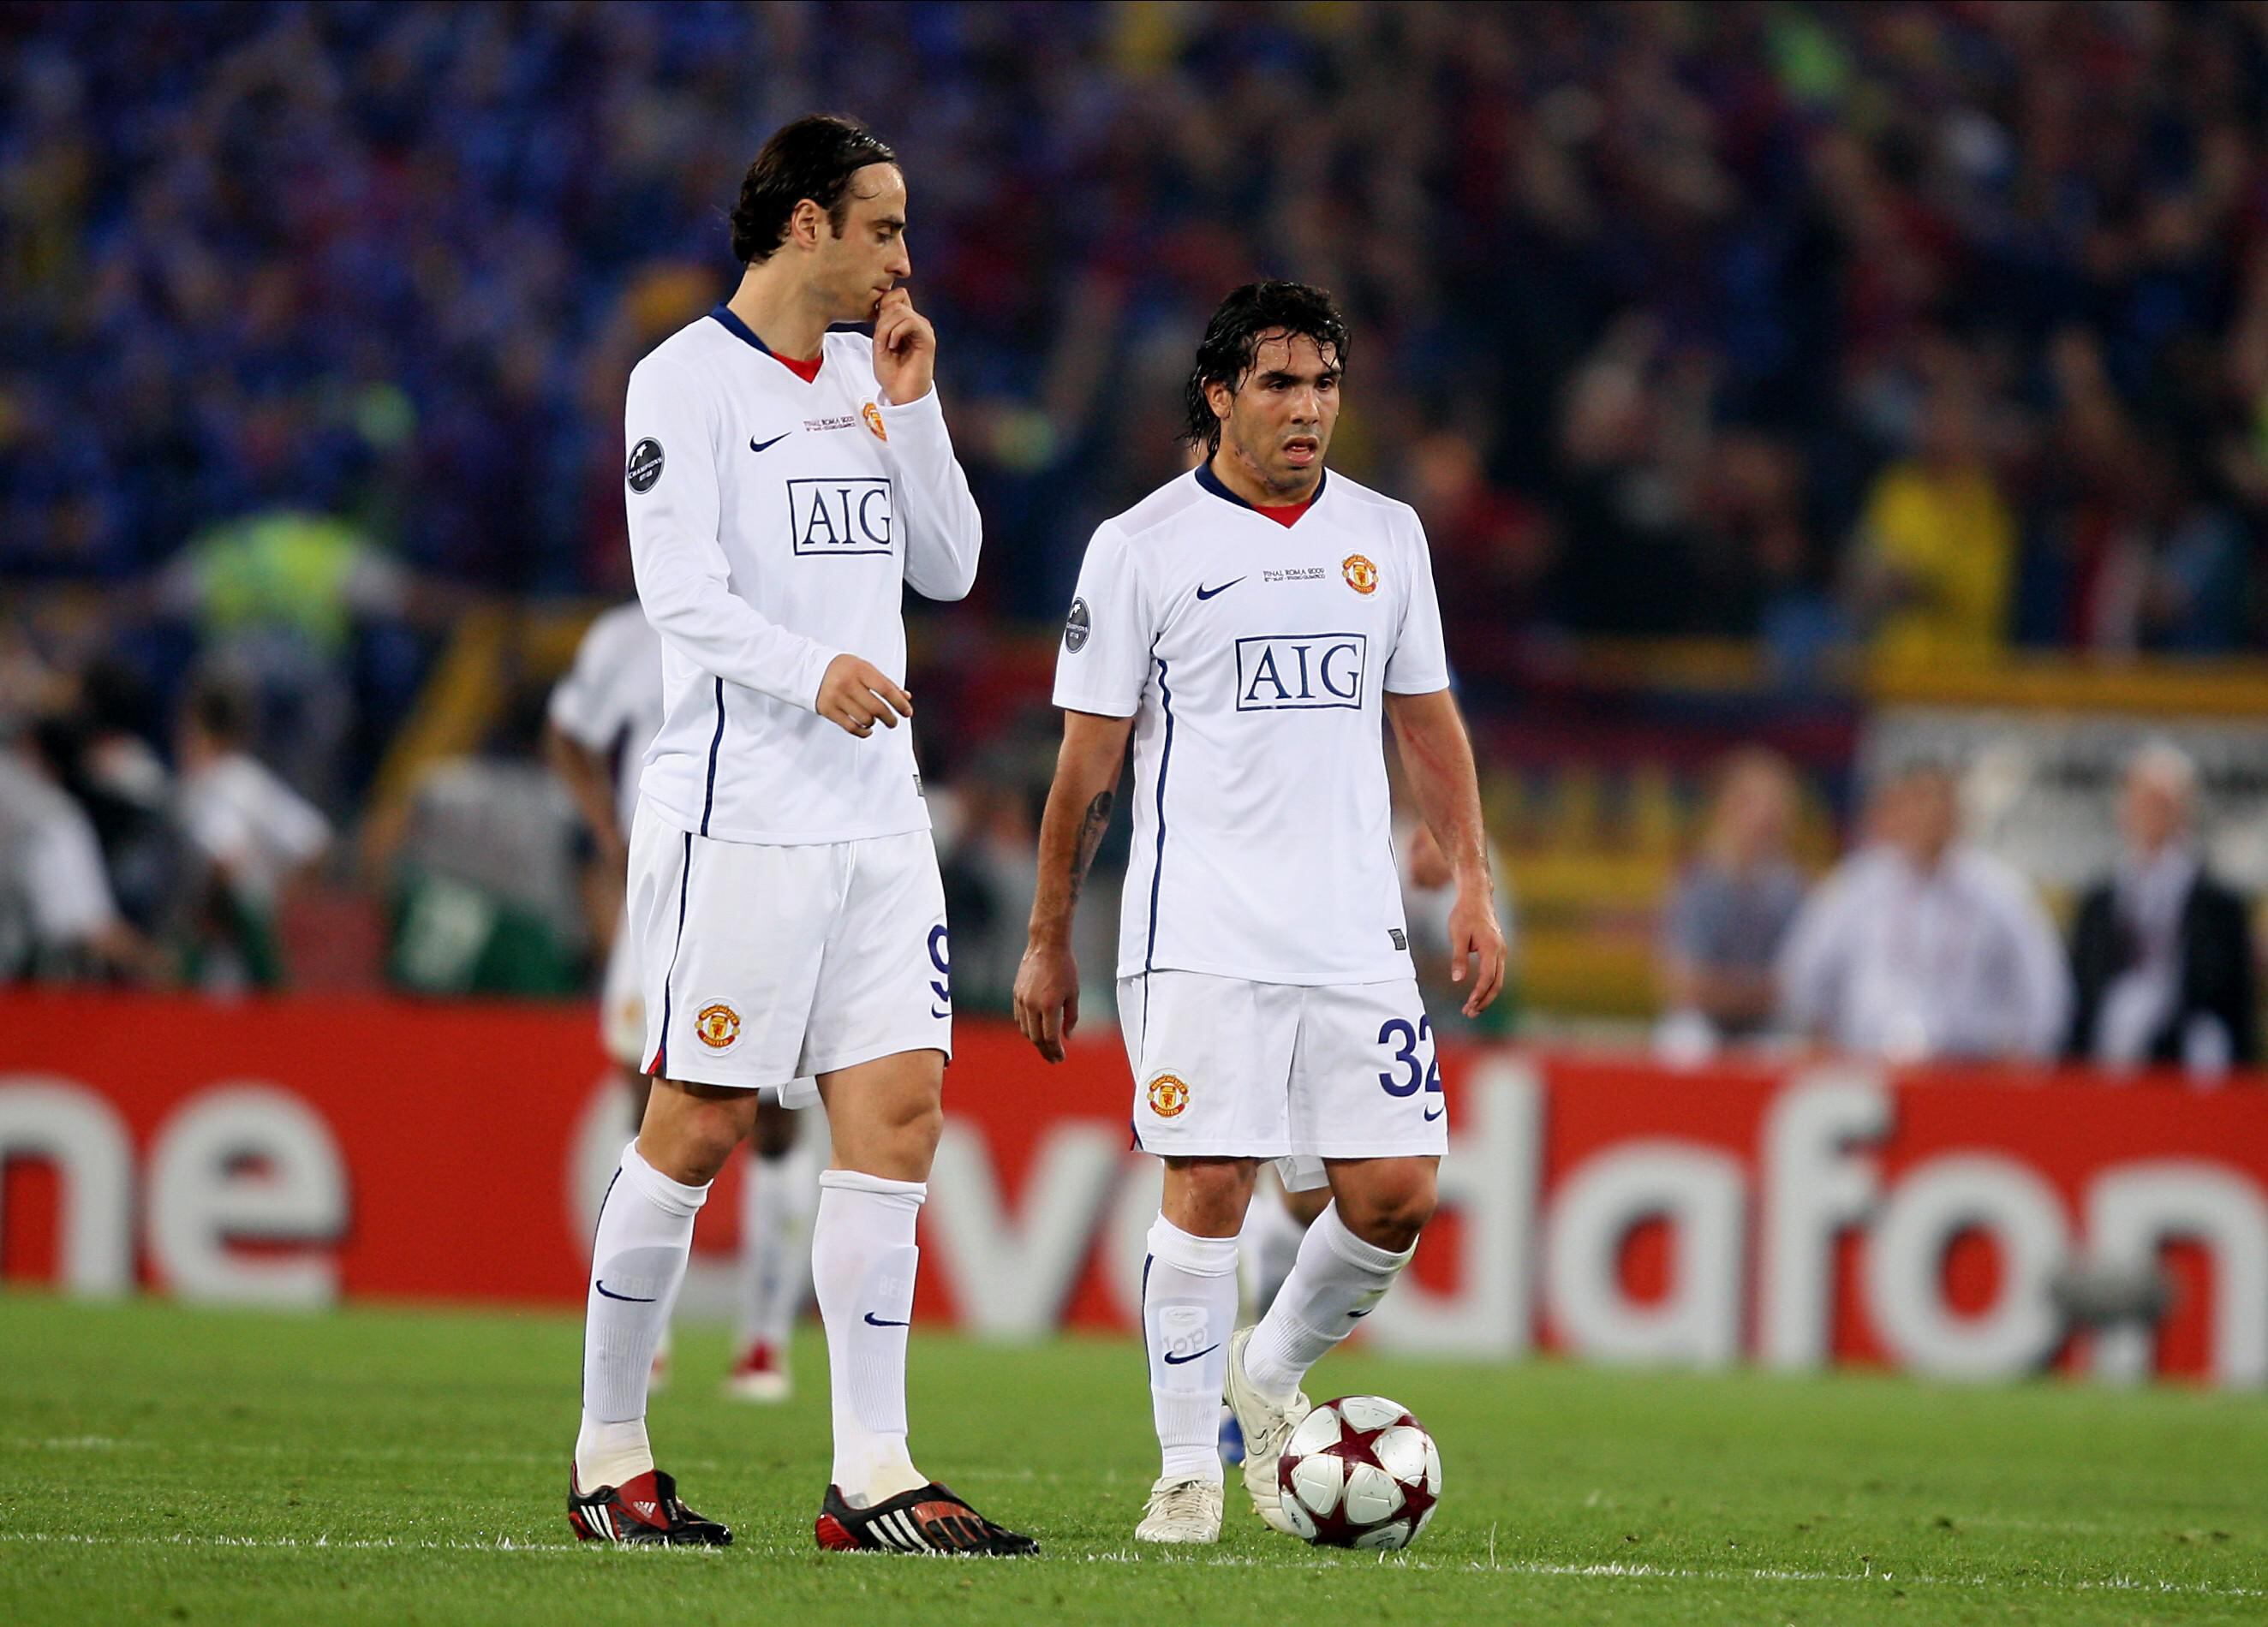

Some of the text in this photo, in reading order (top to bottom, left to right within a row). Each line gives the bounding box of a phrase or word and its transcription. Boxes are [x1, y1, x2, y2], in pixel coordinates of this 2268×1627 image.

[801, 487, 892, 545] AIG
[1244, 643, 1358, 701] AIG
[1377, 1010, 1444, 1098] 32
